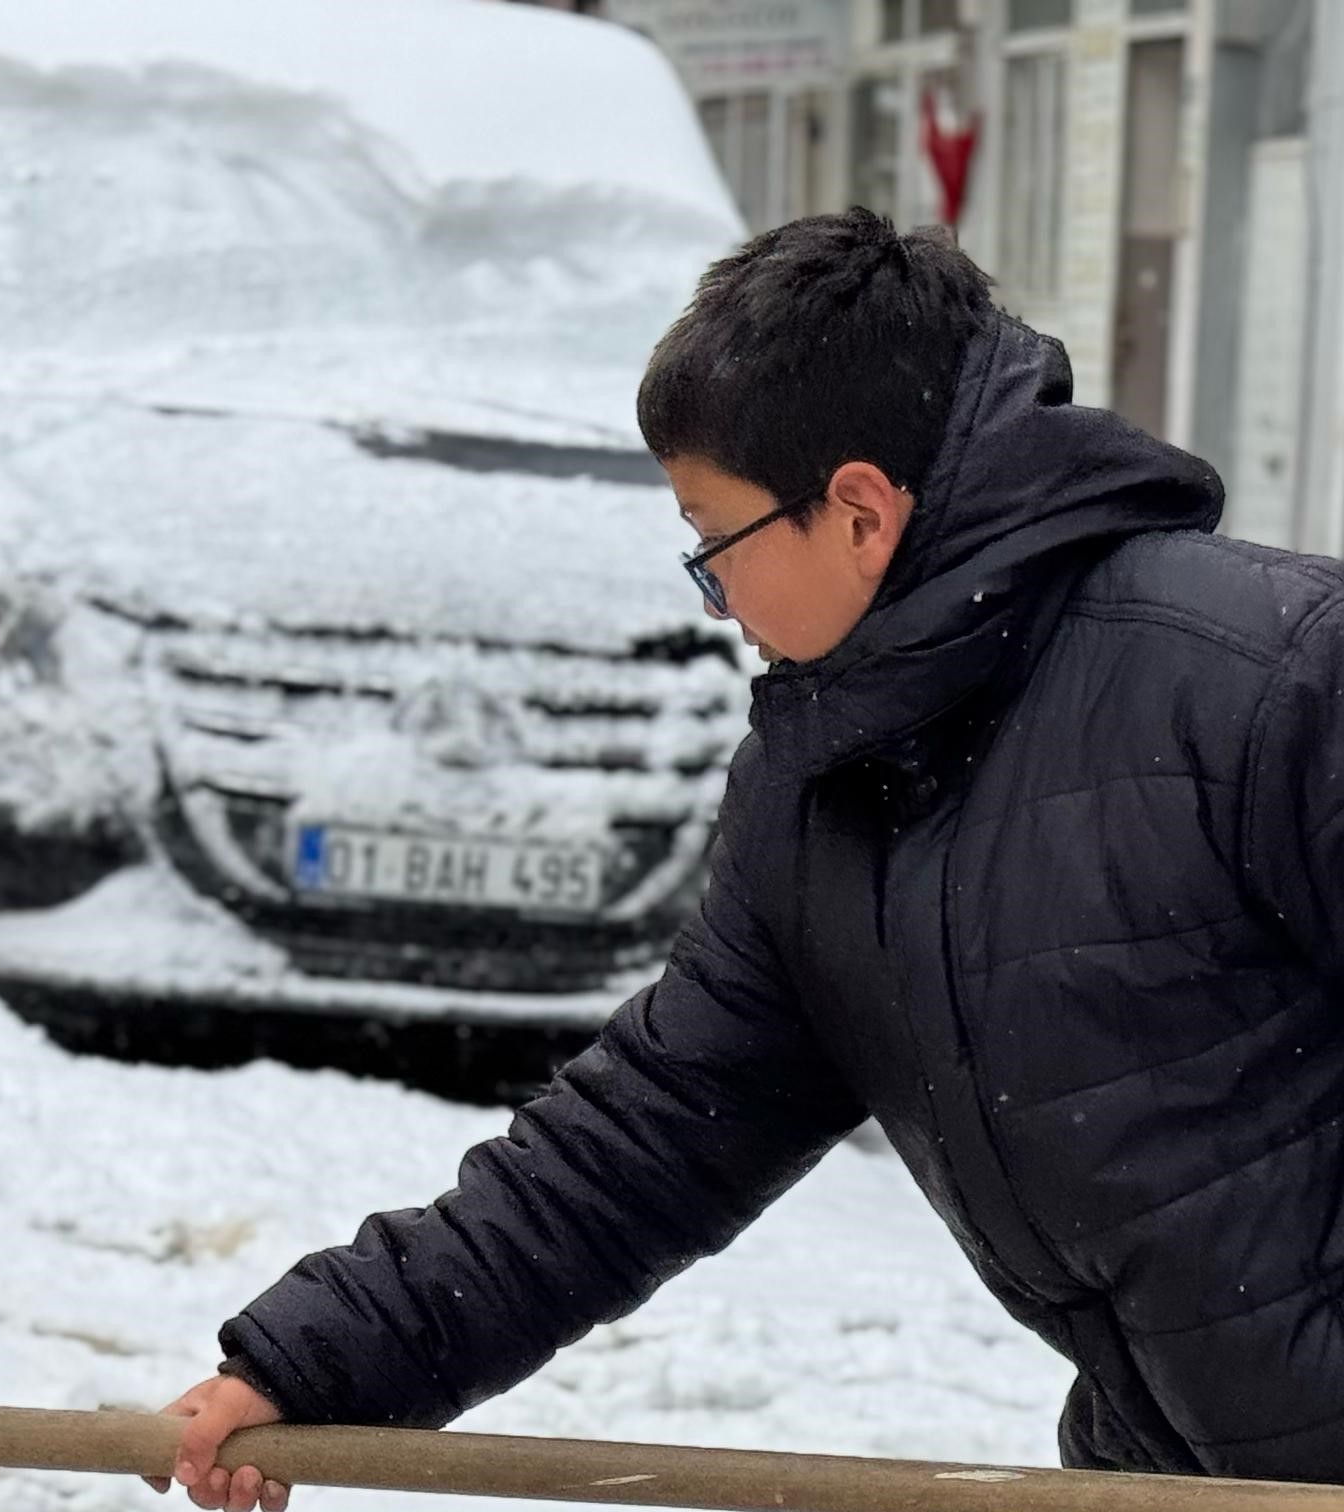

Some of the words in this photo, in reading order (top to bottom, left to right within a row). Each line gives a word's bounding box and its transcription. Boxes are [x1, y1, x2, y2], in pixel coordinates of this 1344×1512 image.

[330, 839, 378, 891] 01
[407, 845, 489, 894] BAH
[512, 853, 590, 901] 495
